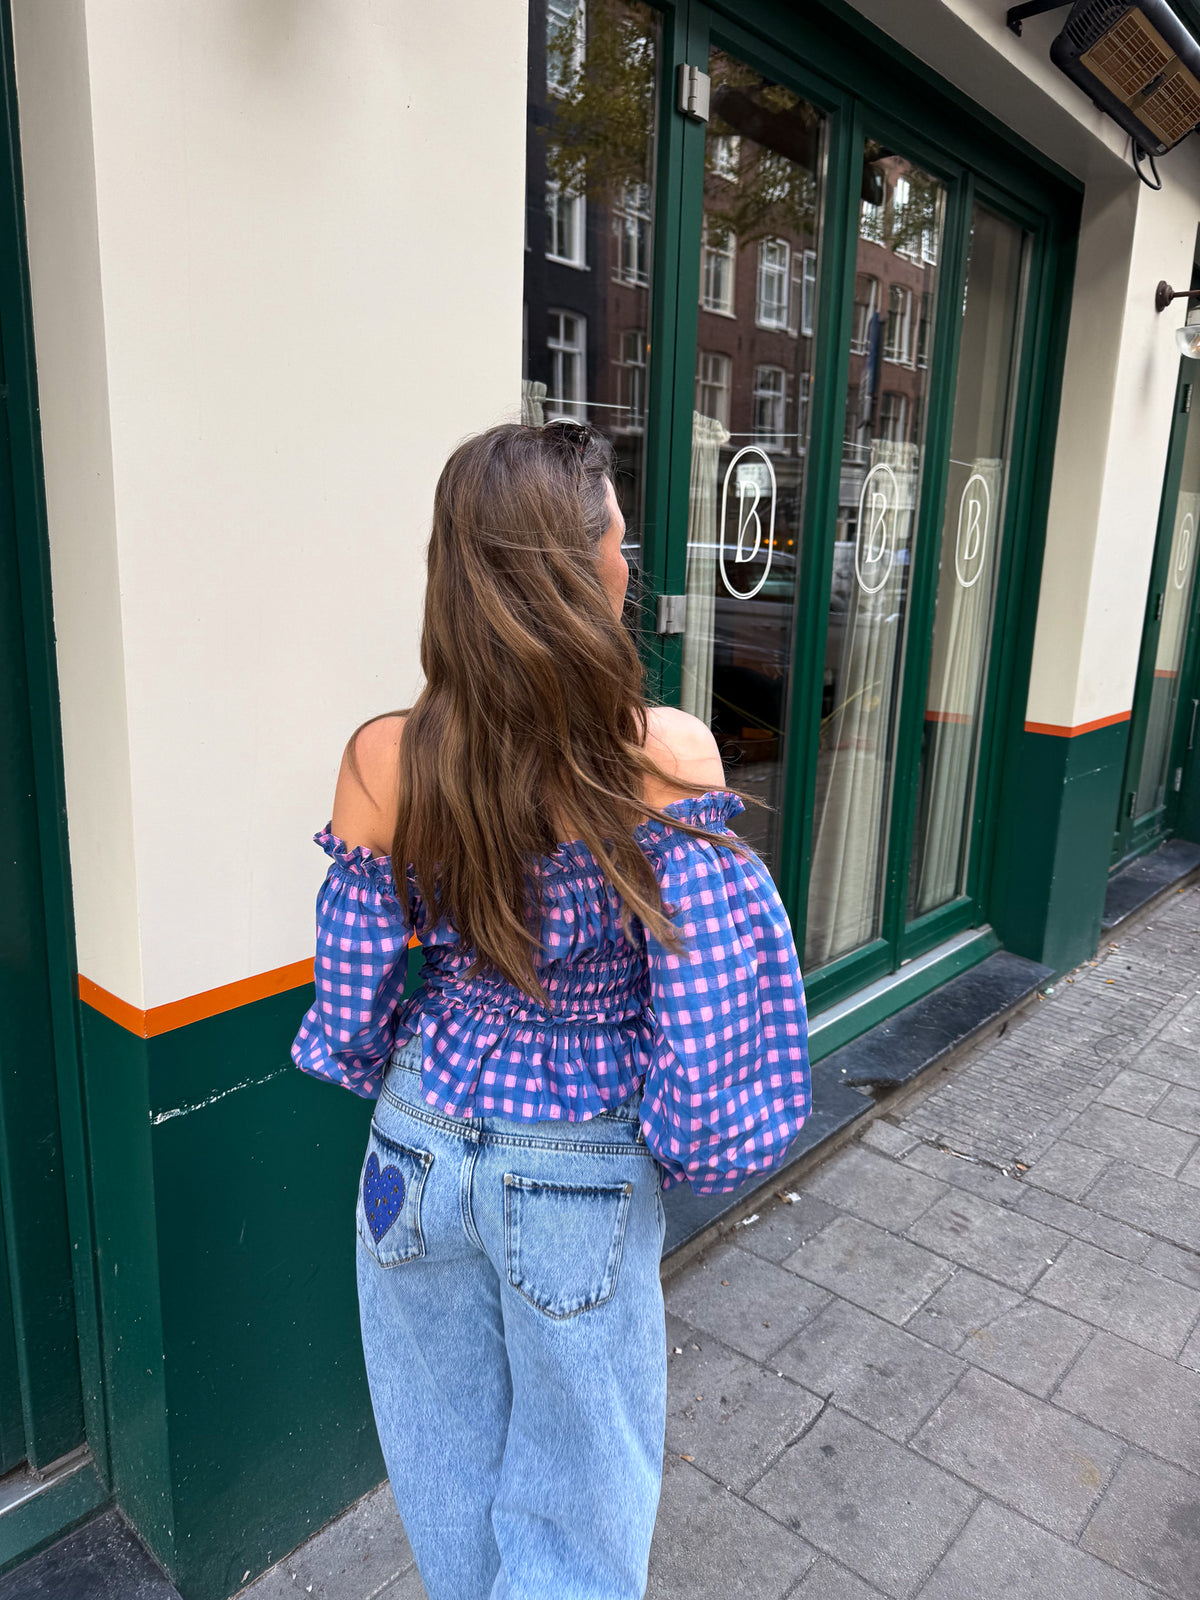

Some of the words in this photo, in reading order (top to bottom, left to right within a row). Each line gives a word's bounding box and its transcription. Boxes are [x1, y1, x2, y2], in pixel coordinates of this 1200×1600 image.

[735, 480, 761, 563] B
[865, 493, 886, 563] B
[964, 499, 981, 559] B
[1178, 530, 1189, 571] B
